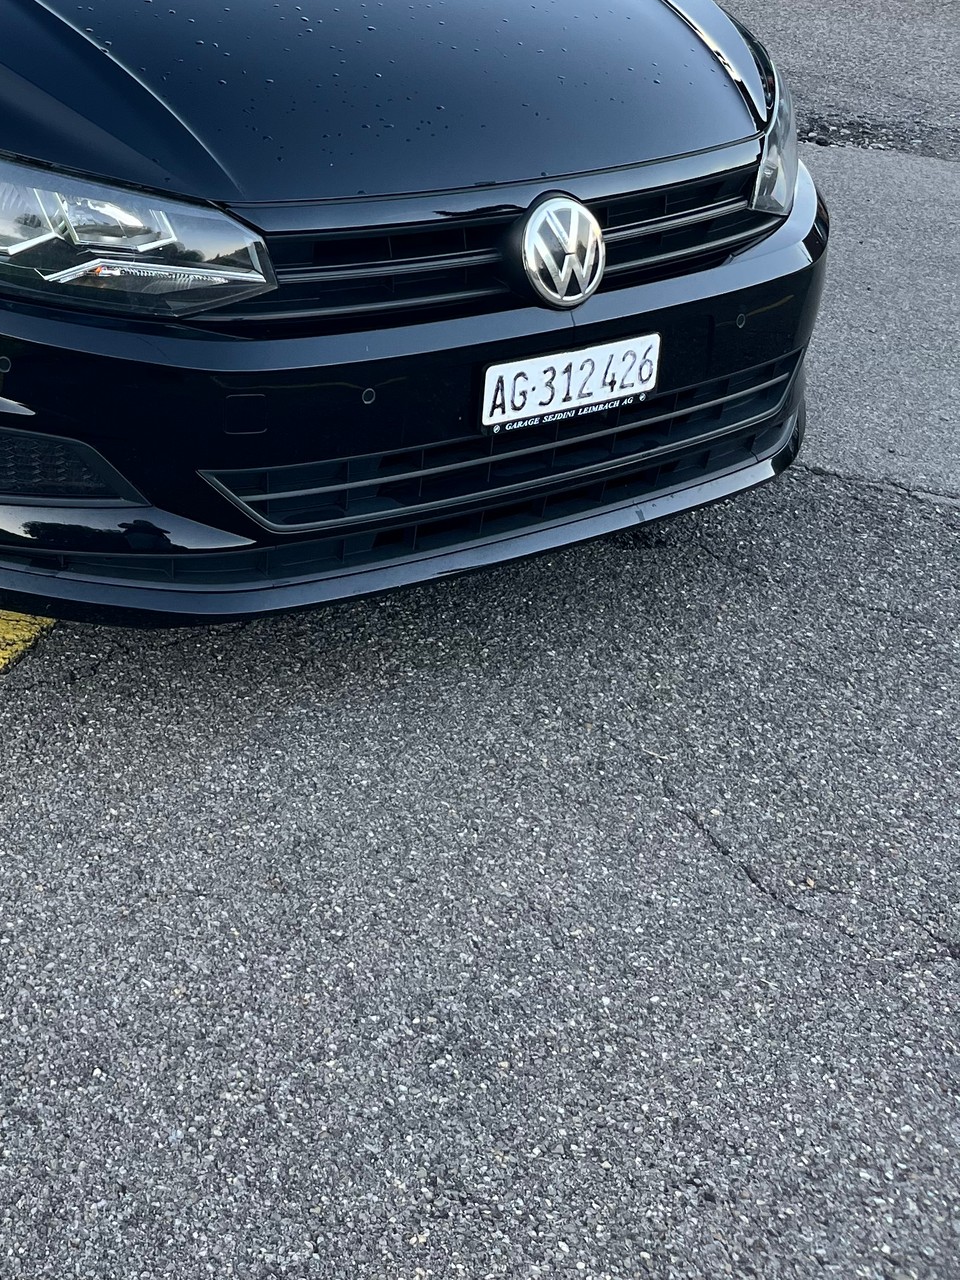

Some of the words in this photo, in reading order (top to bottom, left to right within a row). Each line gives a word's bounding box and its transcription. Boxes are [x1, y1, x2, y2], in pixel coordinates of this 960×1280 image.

[505, 417, 540, 431] GARAGE
[542, 409, 575, 423] SEJDINI
[577, 400, 620, 416] LEIMBACH
[621, 396, 634, 406] AG
